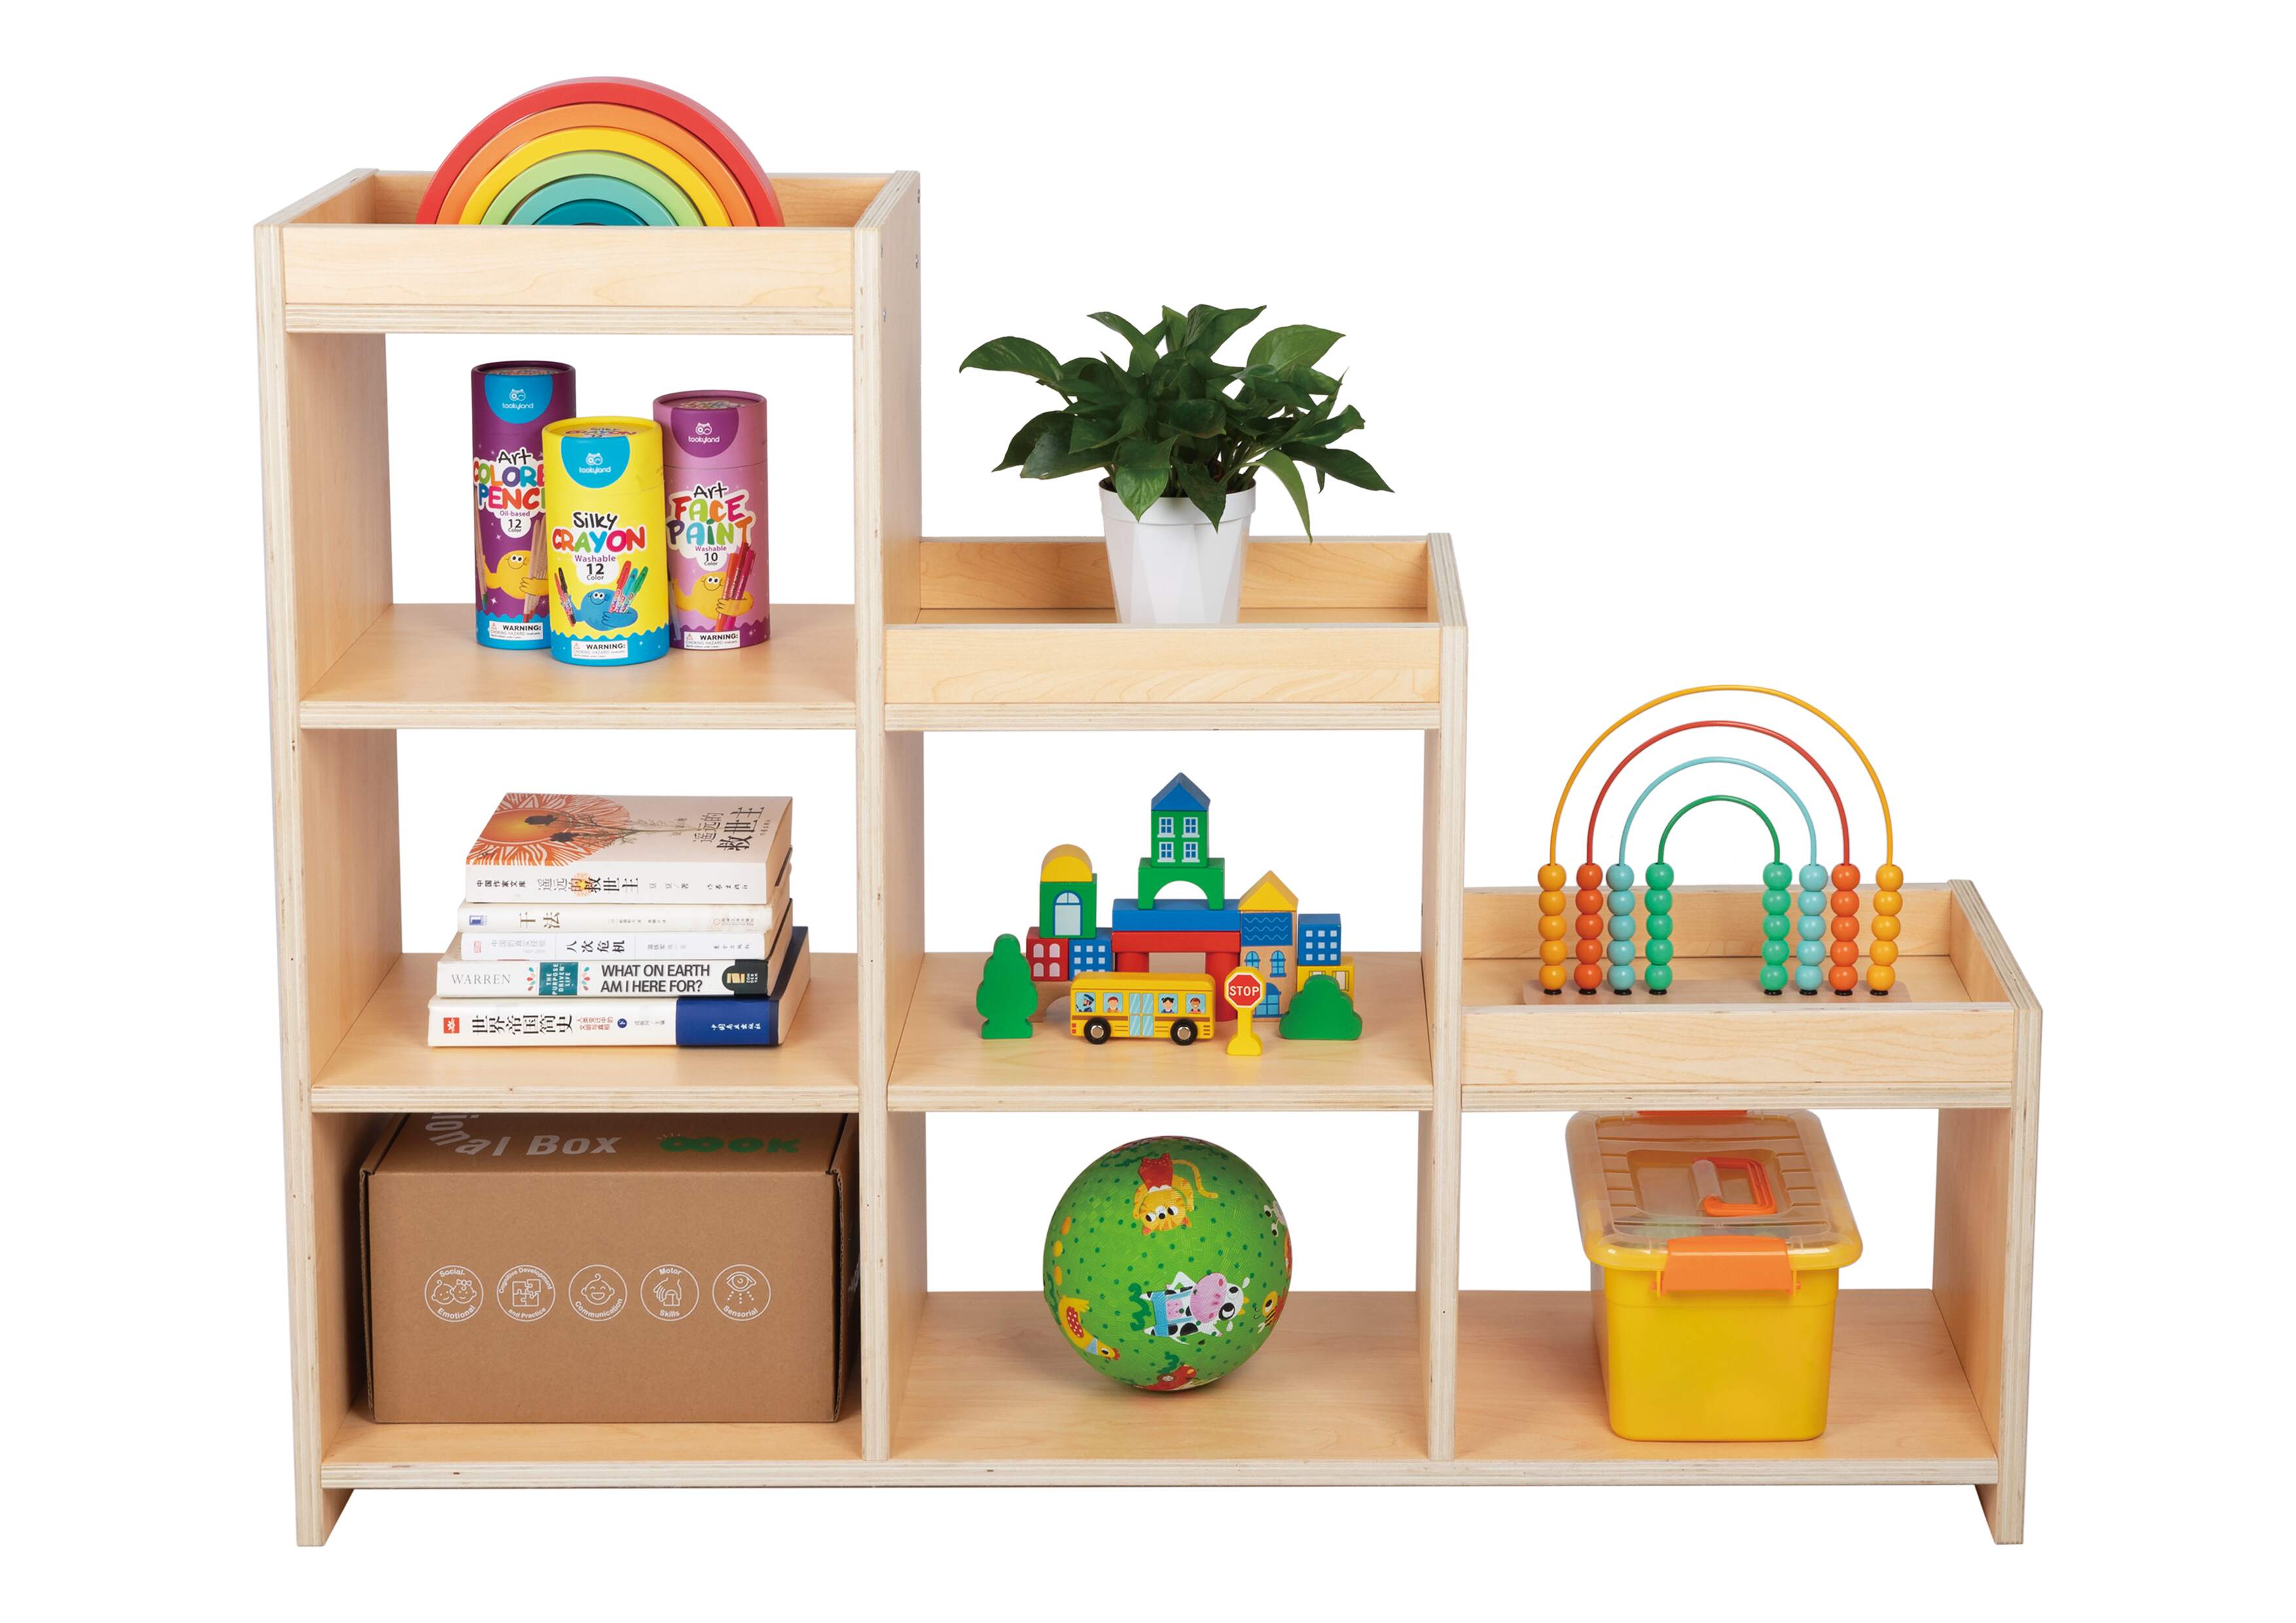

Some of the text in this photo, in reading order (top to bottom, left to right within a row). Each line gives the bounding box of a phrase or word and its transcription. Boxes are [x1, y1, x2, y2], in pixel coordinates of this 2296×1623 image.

[498, 449, 531, 465] Art
[579, 466, 611, 474] tookyland
[694, 482, 728, 499] Art
[672, 495, 745, 522] FACE
[508, 519, 522, 528] 12
[573, 512, 618, 531] Silky
[552, 526, 645, 554] CRAYON
[575, 554, 617, 563] Washable
[704, 552, 718, 562] 10
[586, 563, 604, 575] 12
[692, 813, 724, 842] 遥远的
[716, 807, 764, 851] 救世主
[537, 877, 639, 893] 遥远的救世主
[566, 940, 625, 953] 八次危机
[601, 964, 710, 977] WHAT ON EARTH
[452, 974, 511, 985] WARREN
[600, 980, 703, 992] AM I HERE FOR?
[1229, 985, 1260, 996] STOP
[472, 1014, 573, 1036] 世界帝国简史
[425, 1112, 622, 1156] ional Box
[659, 1267, 682, 1275] Motor
[499, 1267, 552, 1294] Cognitive Development
[437, 1305, 476, 1319] Emotional
[508, 1307, 547, 1319] and Practice
[575, 1298, 623, 1318] Communication
[659, 1309, 680, 1317] Skills
[723, 1305, 759, 1317] Sensorial
